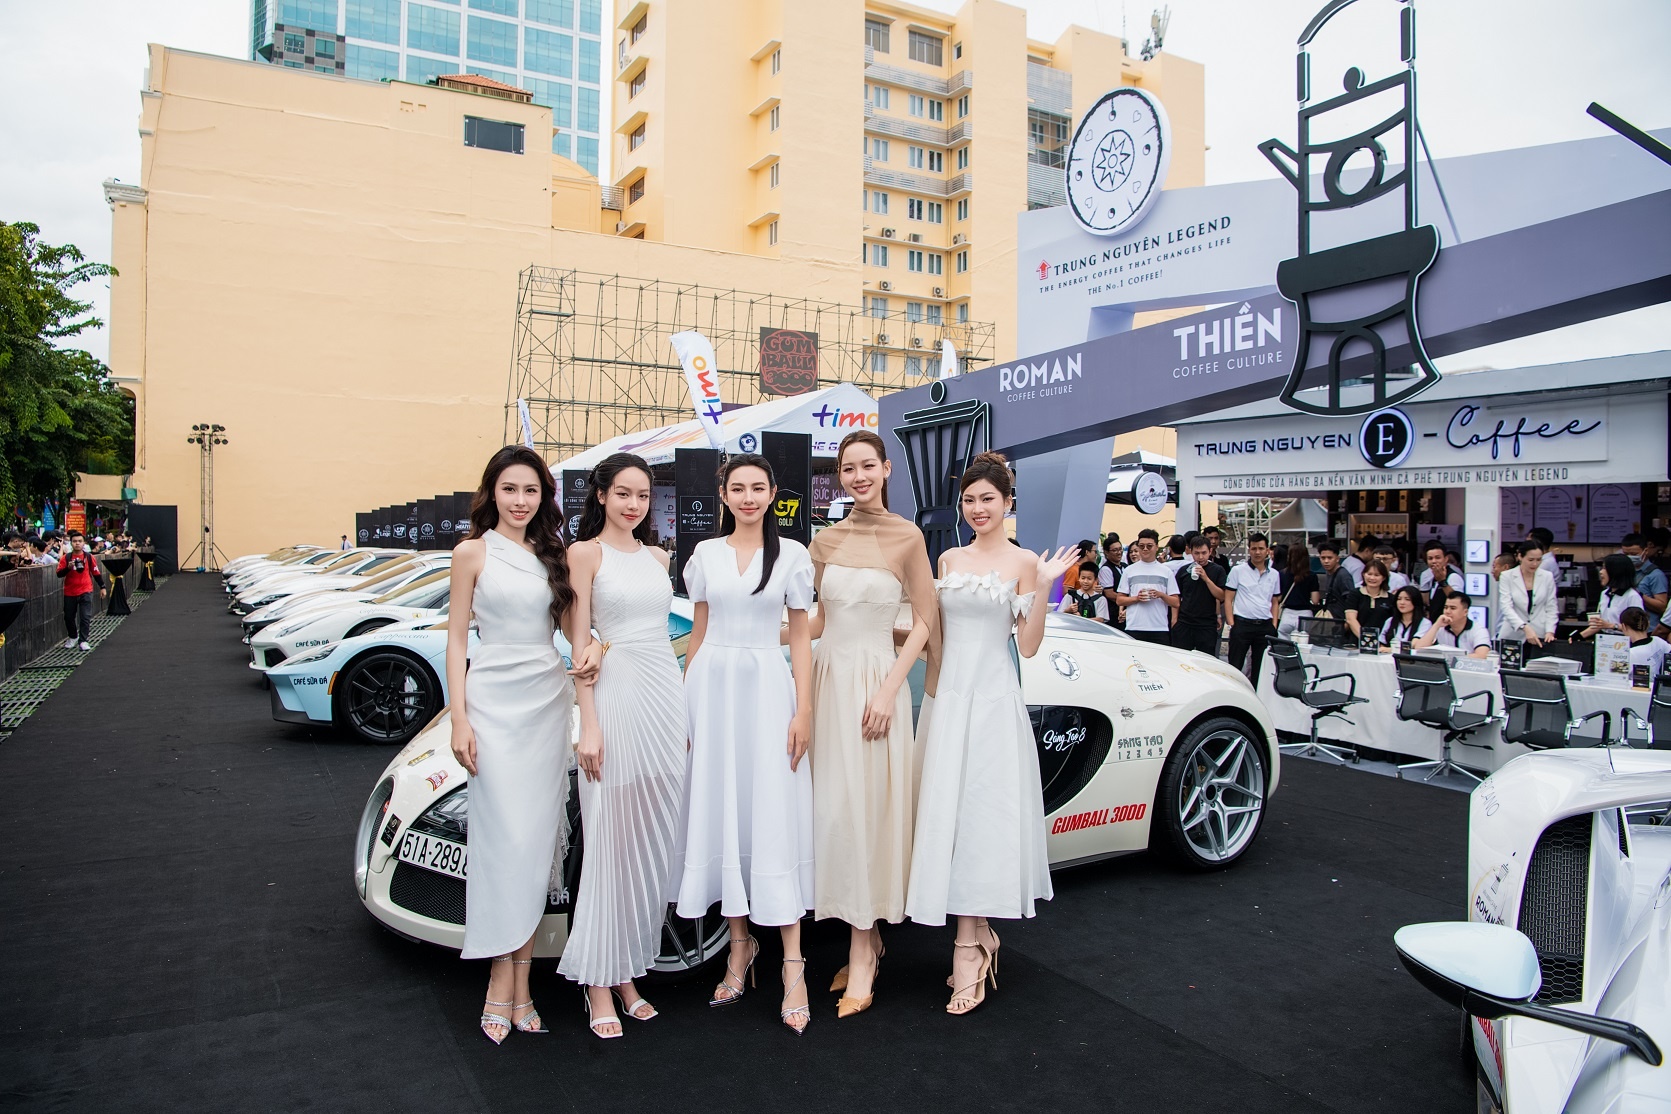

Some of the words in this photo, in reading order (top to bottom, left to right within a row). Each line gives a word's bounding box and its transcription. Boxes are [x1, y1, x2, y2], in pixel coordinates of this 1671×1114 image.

[1054, 255, 1096, 276] TRUNG
[1102, 236, 1160, 263] NGUYÊN
[1168, 216, 1231, 244] LEGEND
[1040, 284, 1054, 293] THE
[1059, 275, 1088, 289] ENERGY
[1093, 266, 1123, 279] COFFEE
[1128, 258, 1152, 270] THAT
[1157, 245, 1202, 262] CHANGES
[1208, 237, 1231, 249] LIFE
[1088, 286, 1102, 295] THE
[1106, 280, 1123, 291] No.1
[1128, 269, 1163, 286] COFFEE!
[1173, 302, 1282, 360] THIỀN
[763, 353, 816, 371] BALL
[1000, 352, 1082, 393] ROMAN
[1173, 361, 1219, 379] COFFEE
[1227, 351, 1283, 370] CULTURE
[1007, 391, 1036, 403] COFFEE
[1039, 385, 1073, 398] CULTURE
[1194, 440, 1257, 456] TRUNG
[1262, 433, 1352, 452] NGUYEN
[1375, 422, 1395, 455] E
[1446, 405, 1602, 460] Coffee
[1223, 478, 1243, 491] CỘNG
[1289, 474, 1310, 487] HÀNG
[1313, 476, 1325, 487] BA
[1348, 473, 1366, 486] VĂN
[1370, 474, 1393, 485] MINH
[1397, 471, 1410, 484] CÀ
[1414, 470, 1432, 483] PHÊ
[1437, 471, 1471, 483] TRUNG
[1475, 468, 1519, 482] NGUYÊN
[1524, 467, 1569, 481] LEGEND
[813, 486, 830, 500] SỨC
[774, 499, 800, 517] G7
[778, 518, 793, 527] GOLD
[295, 640, 309, 648] CAFÉ
[293, 677, 306, 685] CAFÉ
[1043, 729, 1066, 752] Sáng
[1078, 727, 1087, 742] 8
[1126, 751, 1131, 759] 2
[1136, 749, 1141, 758] 3
[1158, 748, 1164, 756] 5
[1051, 807, 1111, 835] GUMBALL
[1110, 803, 1147, 824] 3000
